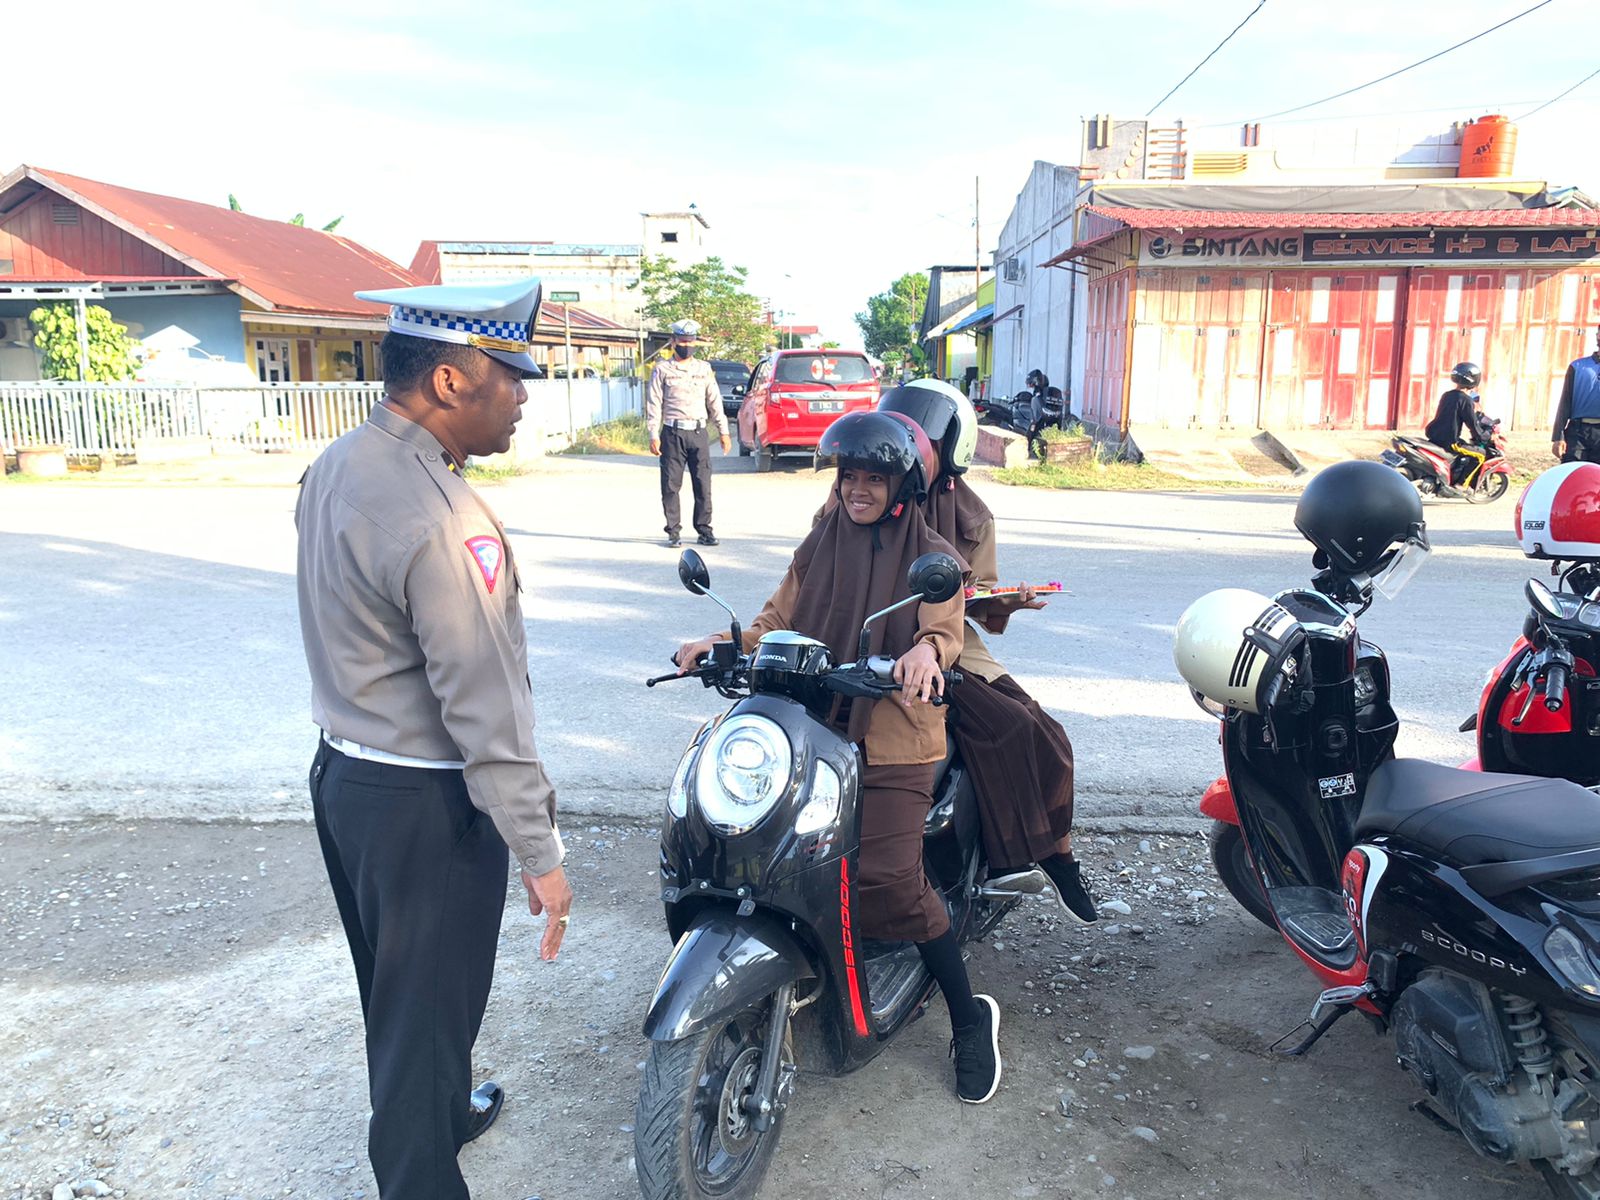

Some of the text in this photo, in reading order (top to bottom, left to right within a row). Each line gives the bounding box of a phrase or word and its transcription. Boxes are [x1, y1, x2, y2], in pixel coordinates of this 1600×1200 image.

[1182, 236, 1299, 257] BINTANG
[1312, 238, 1435, 255] SERVICE
[1445, 237, 1486, 254] HP
[1497, 237, 1520, 253] &
[759, 654, 787, 663] HONDA
[1421, 929, 1527, 977] SCOOPY
